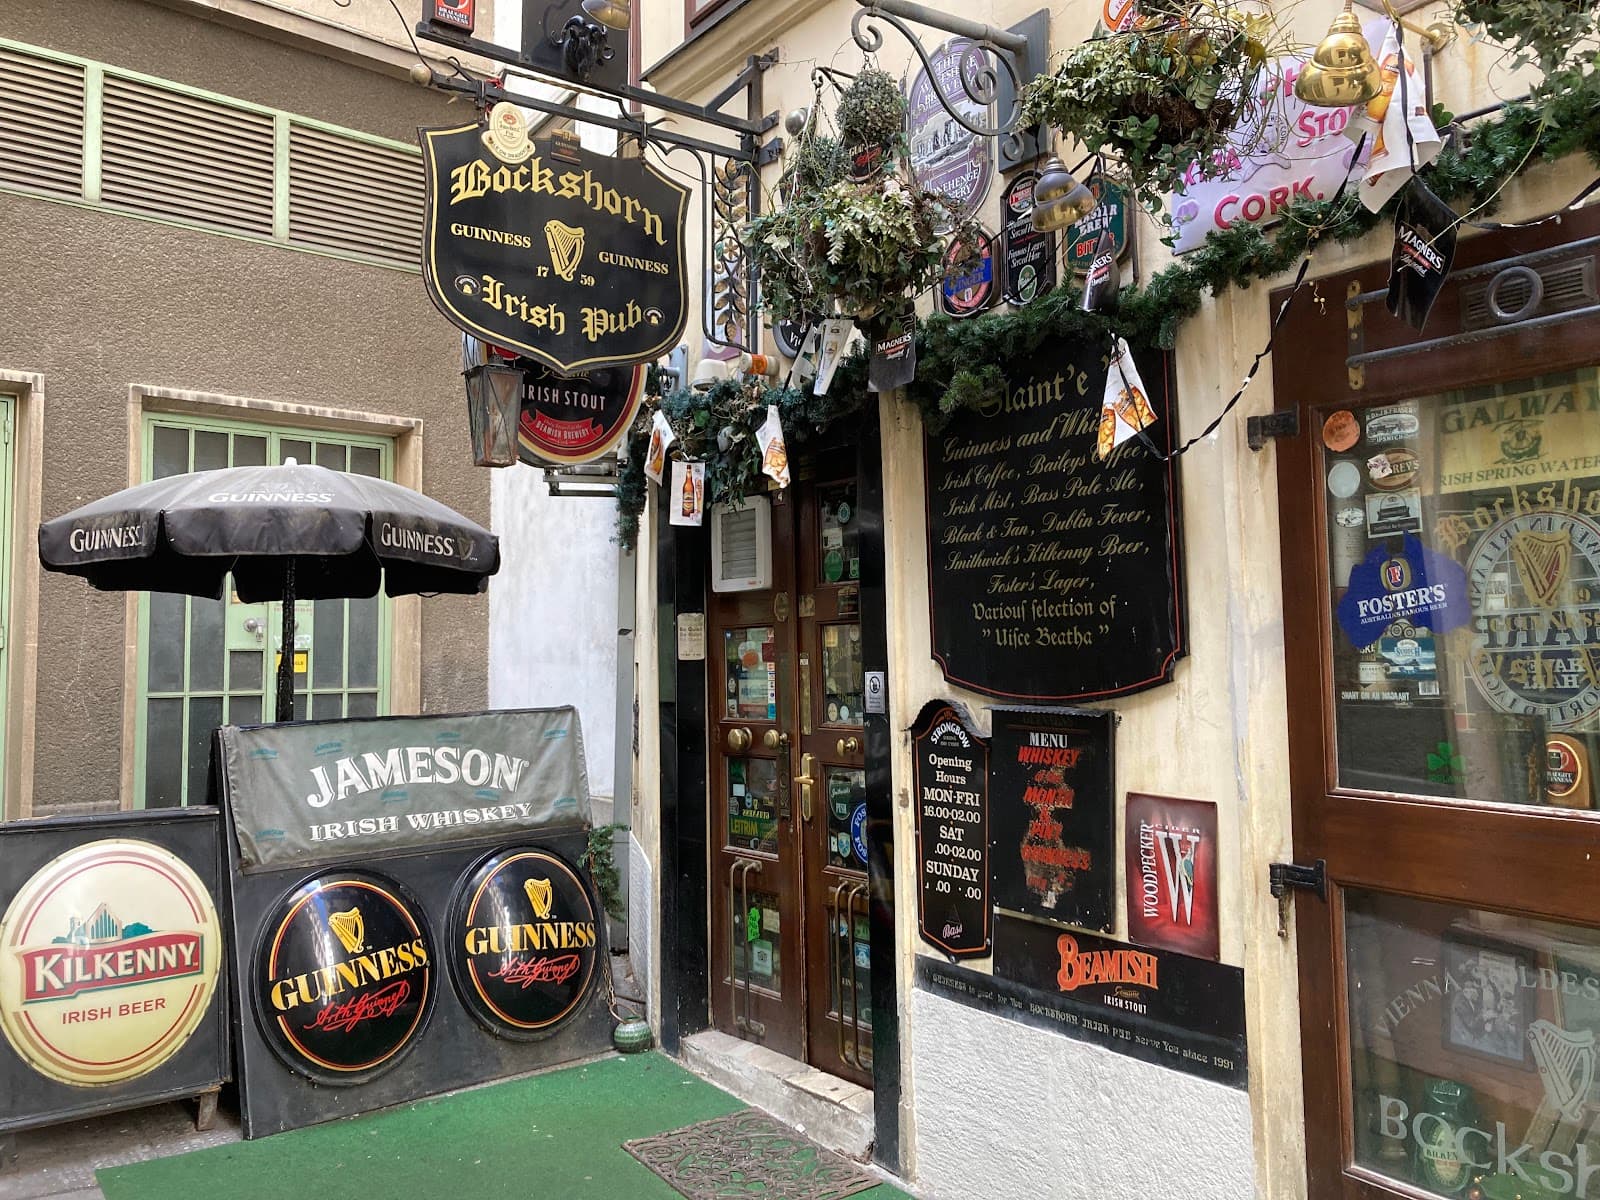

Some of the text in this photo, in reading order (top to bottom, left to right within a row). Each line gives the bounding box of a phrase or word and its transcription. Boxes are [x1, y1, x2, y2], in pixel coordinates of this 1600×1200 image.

[450, 156, 668, 247] Bockshorn
[450, 222, 532, 249] GUINNESS
[1399, 225, 1444, 271] MAGNERS
[535, 265, 596, 287] 17 59
[598, 250, 670, 275] GUINNESS
[481, 273, 643, 343] Irish Pub
[876, 332, 912, 353] MAGNERS
[521, 383, 606, 411] IRISH STOUT
[942, 431, 1012, 463] Guinness
[1016, 416, 1057, 448] and
[938, 469, 972, 491] Irish
[973, 462, 1021, 491] Coffee,
[1026, 450, 1086, 475] Baileys
[1440, 469, 1473, 487] RISH
[1475, 463, 1537, 483] SPRING
[207, 491, 335, 503] GUINNESS
[943, 468, 1144, 517] Irish Mist, Bass Pale Ale,
[941, 503, 1151, 545] Black & Tan, Dublin Fever,
[69, 524, 144, 553] GUINNESS
[380, 522, 455, 556] GUINNESS
[944, 533, 1150, 571] Smithwick's Kilkenny Beer,
[986, 569, 1095, 596] Foster's Lager,
[1099, 594, 1117, 619] of
[1356, 583, 1446, 618] FOSTER'S
[930, 721, 971, 749] STRONGBOW
[1029, 731, 1069, 749] MENU
[928, 753, 973, 772] Opening
[1017, 745, 1081, 768] WHISKEY
[306, 745, 526, 809] JAMESON
[935, 770, 967, 785] Hours
[923, 786, 981, 807] MON-FRI
[309, 802, 534, 842] IRISH WHISKEY
[939, 825, 965, 841] SAT
[1155, 823, 1201, 834] CIDER
[926, 860, 980, 882] SUNDAY
[1140, 822, 1159, 918] WOODPECKER
[464, 921, 596, 956] GUINNESS
[34, 941, 197, 992] KILKENNY
[270, 939, 430, 1013] GUINNESS
[1056, 933, 1159, 992] BEAMISH
[62, 997, 167, 1025] IRISH BEER
[1103, 993, 1147, 1015] IRISH STOUT
[1213, 1055, 1235, 1071] 1991
